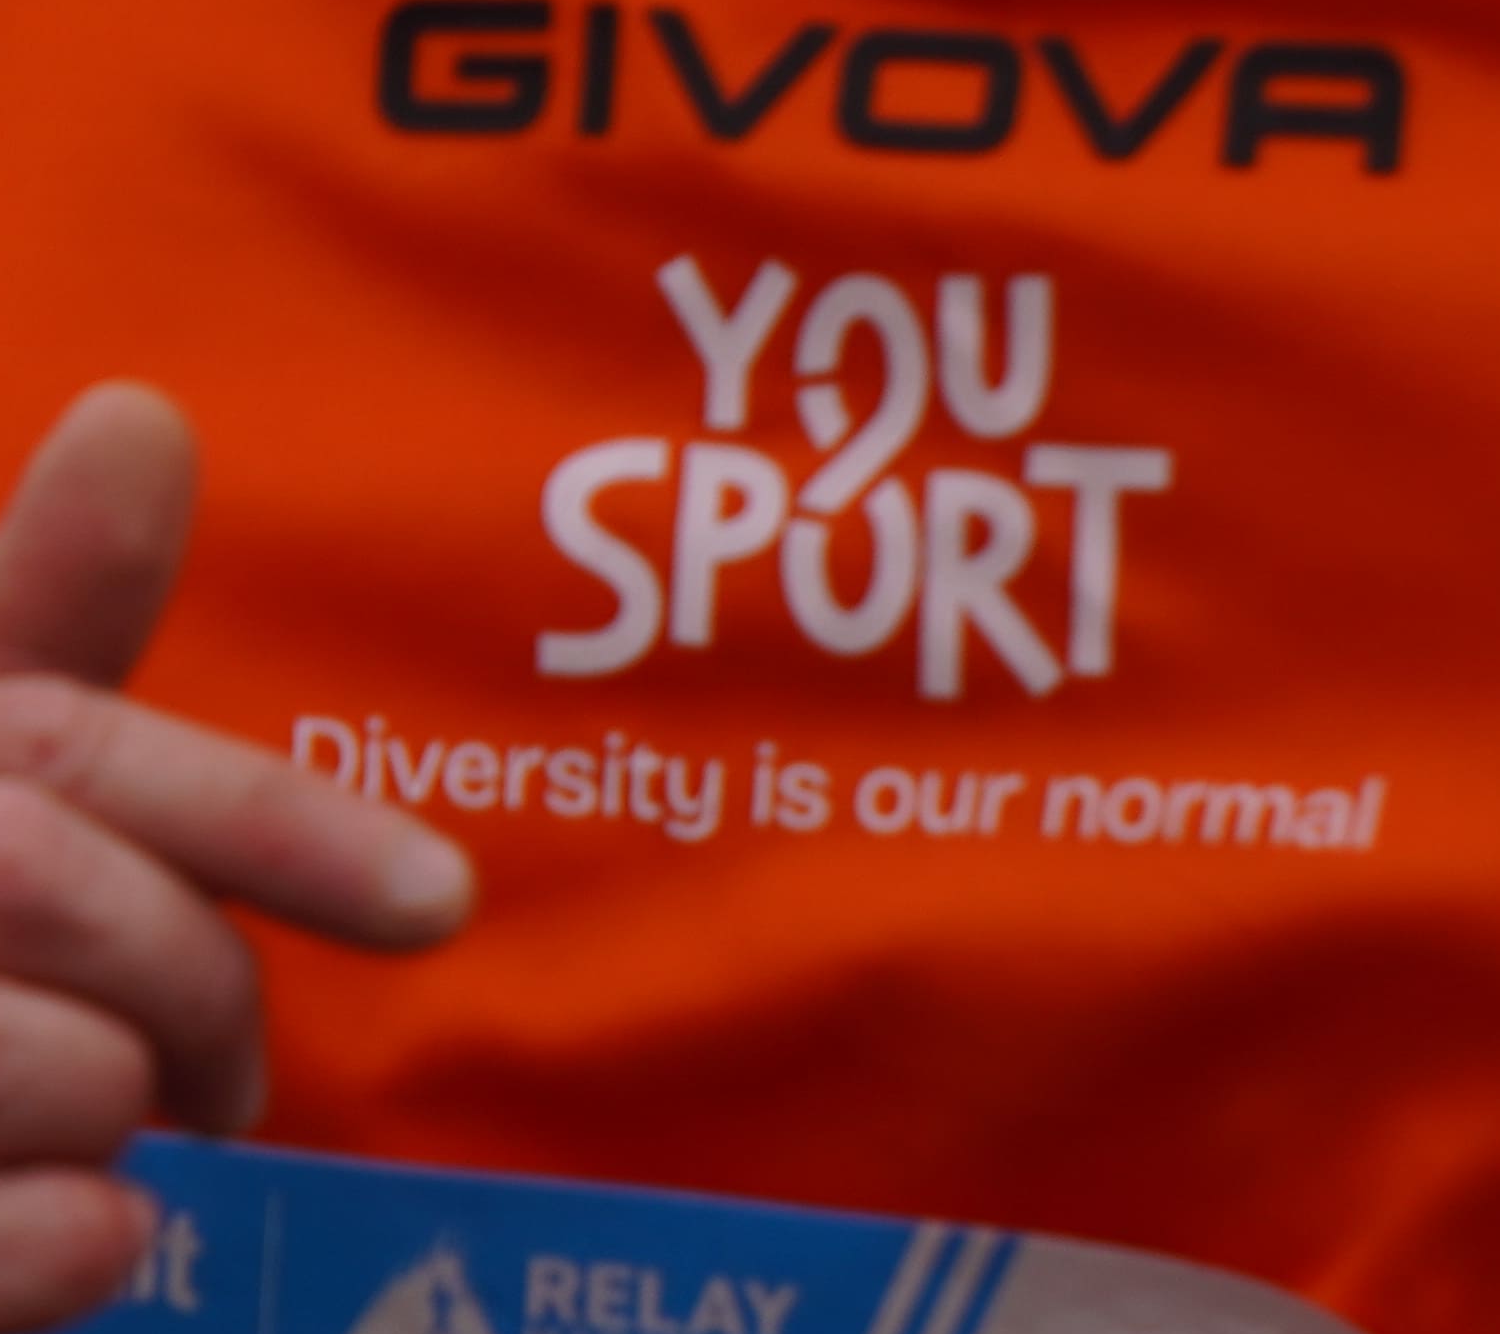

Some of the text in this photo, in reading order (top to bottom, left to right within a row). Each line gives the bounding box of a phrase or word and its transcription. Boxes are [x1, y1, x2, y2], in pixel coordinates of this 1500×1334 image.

[654, 252, 1056, 442] YOU
[533, 435, 1175, 701] SPORT
[289, 709, 1390, 856] Diversity is our normal
